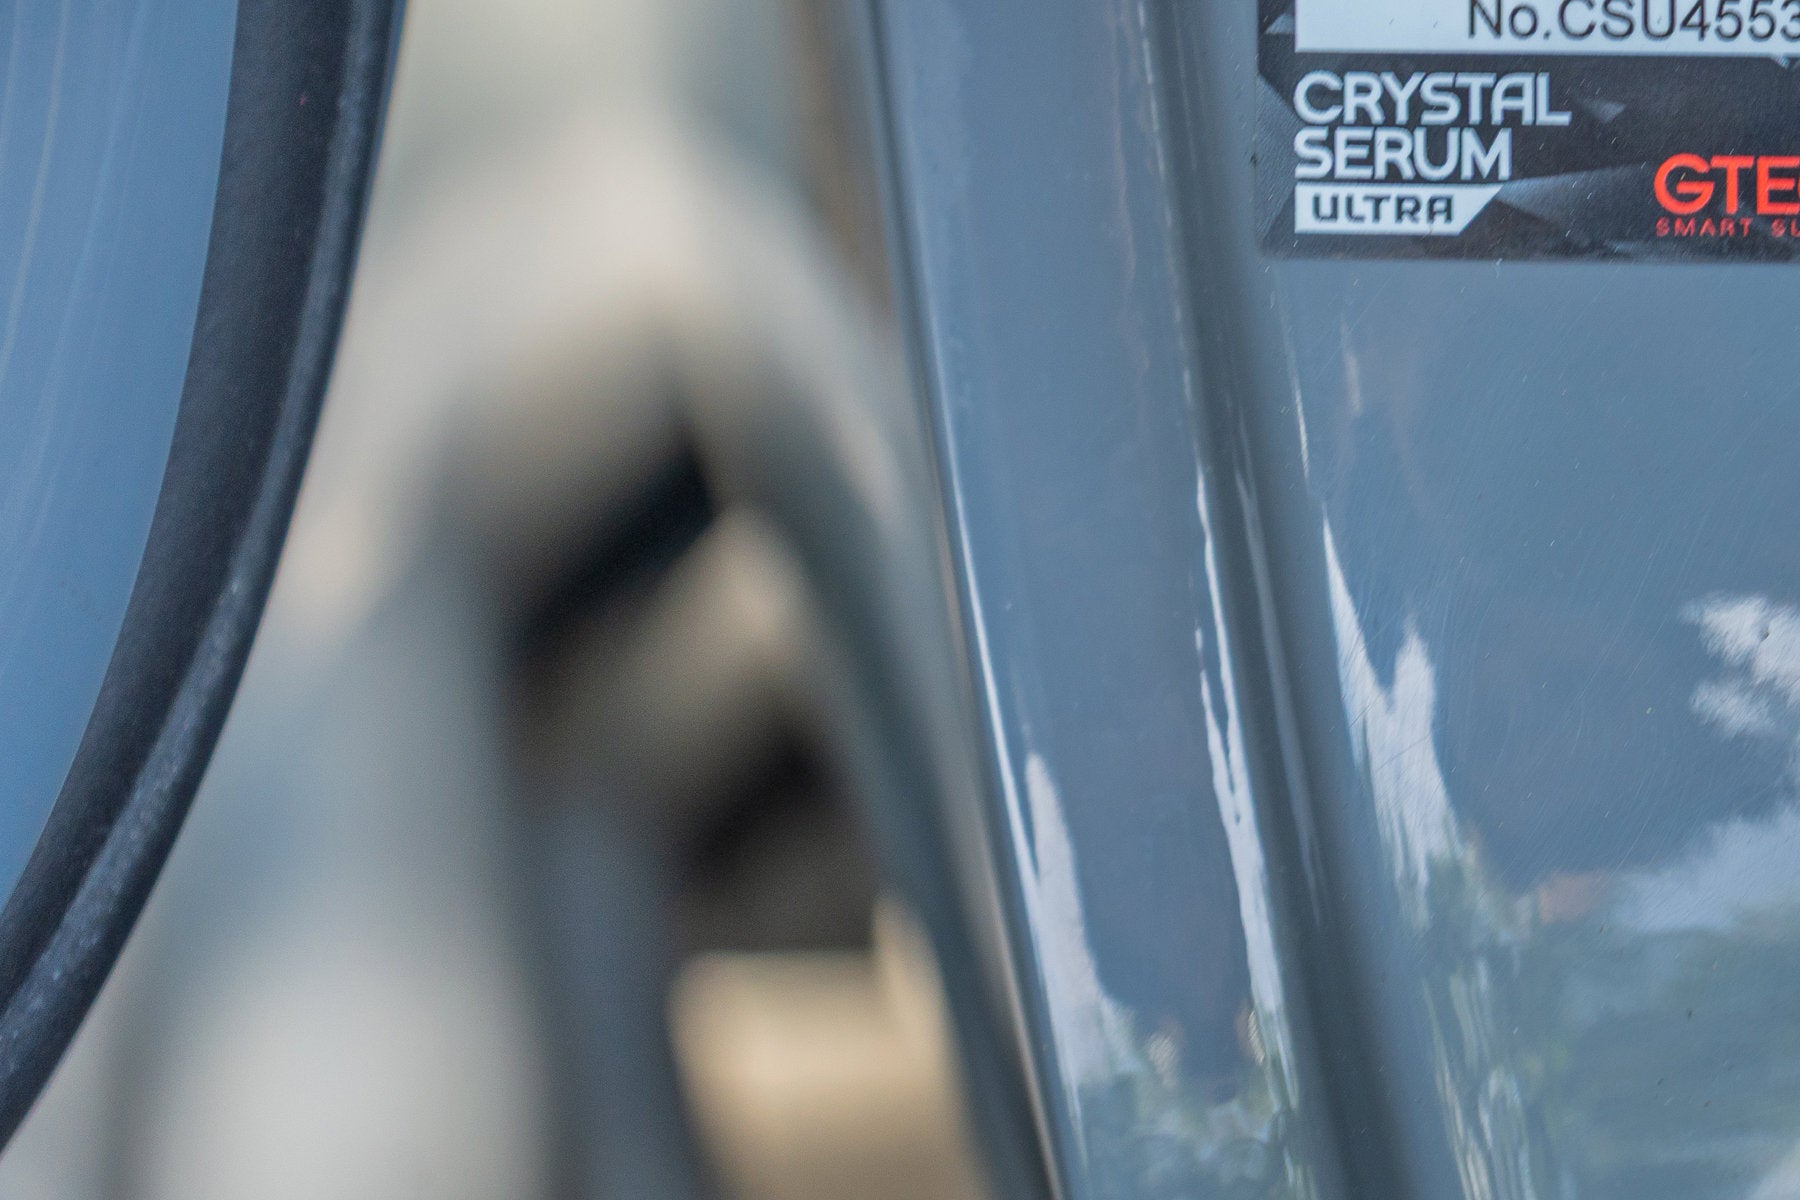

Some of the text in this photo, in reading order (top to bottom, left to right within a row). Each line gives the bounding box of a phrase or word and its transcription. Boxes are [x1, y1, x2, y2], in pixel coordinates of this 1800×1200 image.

[1293, 70, 1573, 126] CRYSTAL
[1293, 126, 1513, 181] SERUM
[1312, 192, 1454, 224] ULTRA
[1655, 217, 1754, 238] SMART
